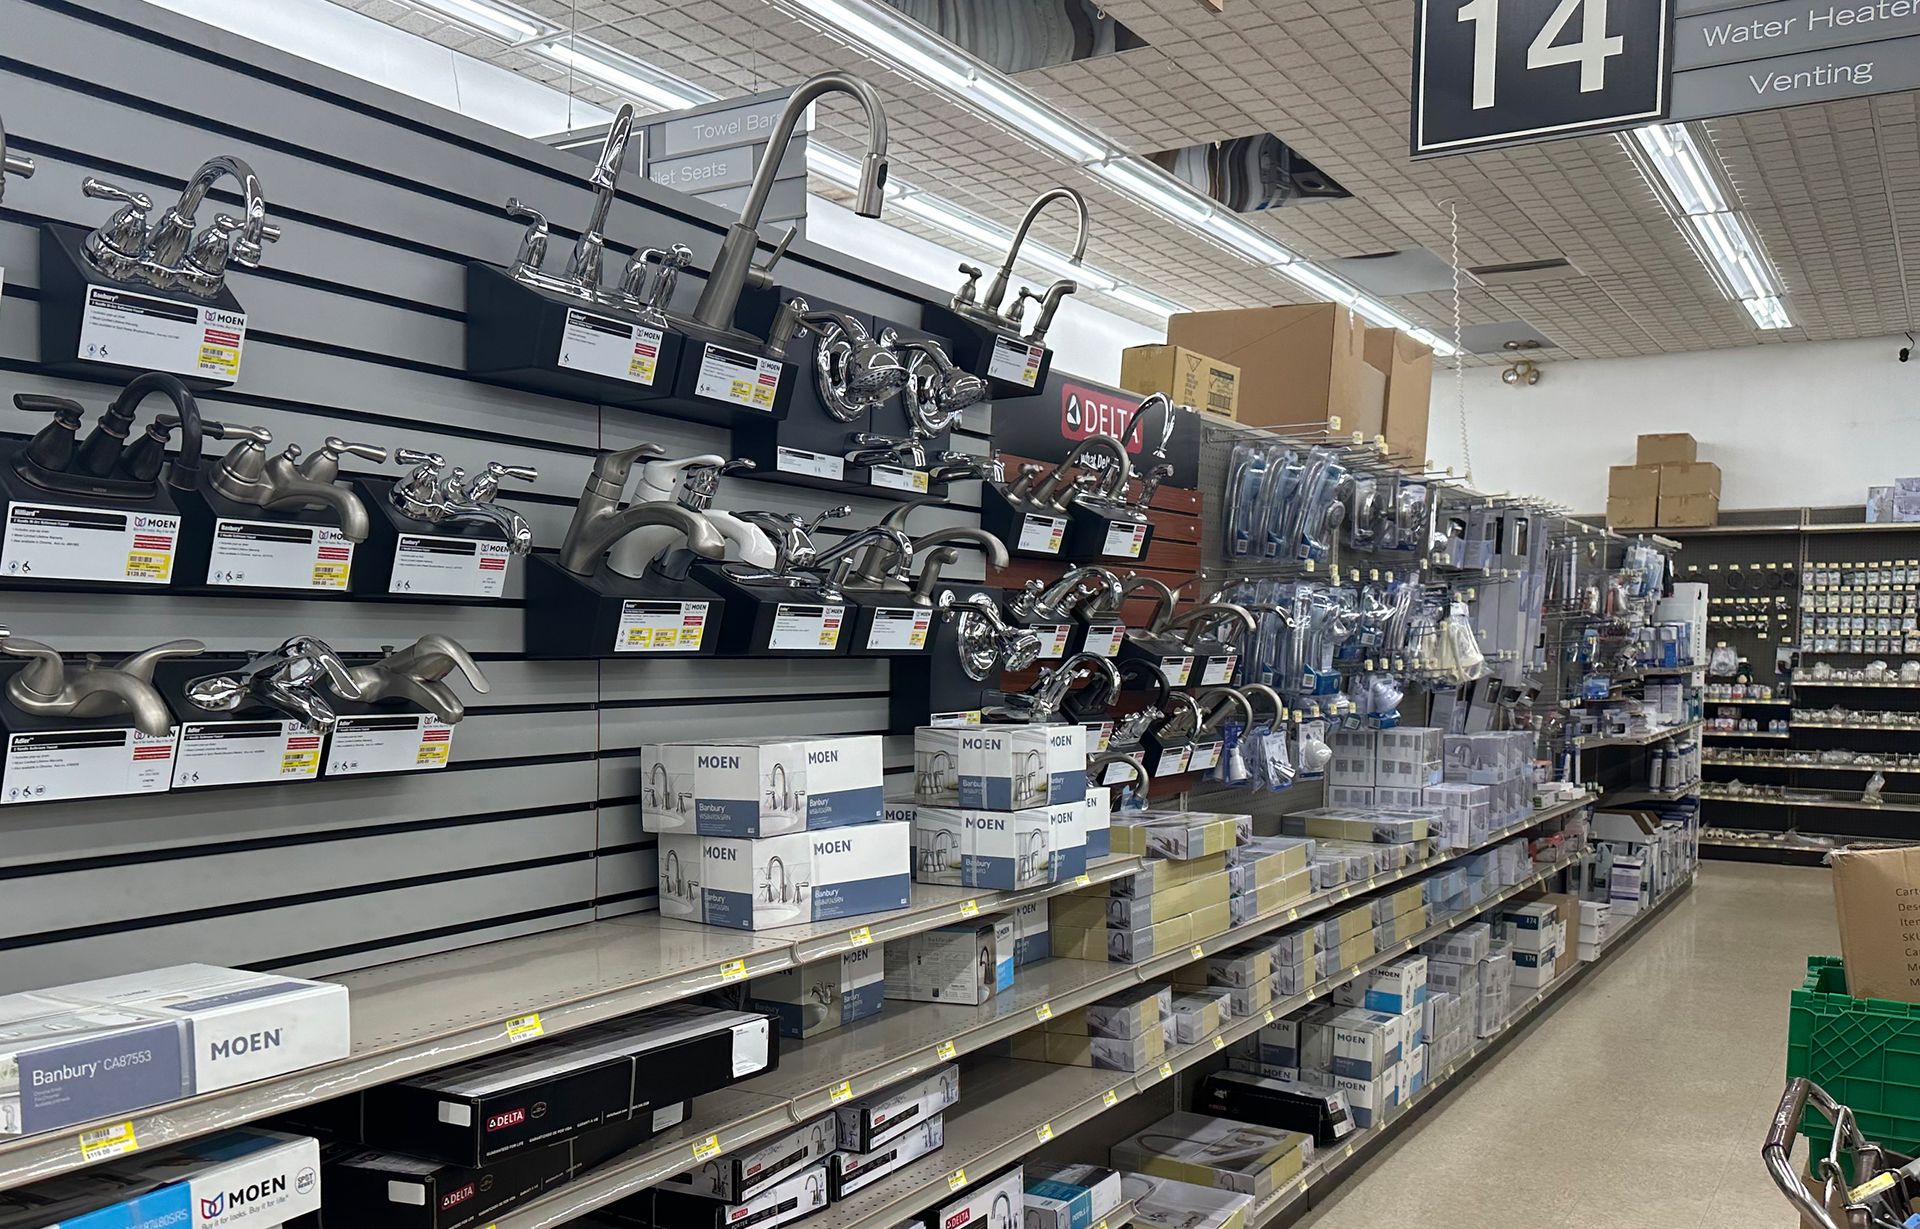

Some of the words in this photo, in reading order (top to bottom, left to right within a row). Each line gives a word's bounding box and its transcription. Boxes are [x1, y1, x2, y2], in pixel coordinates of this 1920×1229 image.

[1703, 16, 1796, 48] Water
[1456, 0, 1624, 110] 14
[1749, 59, 1875, 95] Venting
[693, 115, 741, 140] Towel
[681, 161, 728, 182] Seats
[217, 313, 244, 326] MOEN
[643, 331, 660, 341] MOEN
[147, 519, 177, 529] MOEN
[962, 738, 1001, 751] MOEN
[698, 755, 740, 769] MOEN
[808, 750, 839, 765] MOEN
[699, 803, 725, 813] Banbury
[965, 817, 1005, 831] MOEN
[703, 845, 736, 861] MOEN
[814, 839, 851, 856] MOEN
[843, 948, 869, 965] MOEN
[1378, 969, 1400, 979] MOEN
[211, 1029, 281, 1061] MOEN
[1337, 1033, 1366, 1044] MOEN
[32, 1062, 97, 1087] Banbury
[103, 1049, 152, 1072] CA87553
[1264, 1068, 1291, 1079] MOEN
[1337, 1080, 1366, 1092] MOEN
[497, 1110, 524, 1127] DELTA
[297, 1172, 314, 1184] SPOT
[229, 1174, 286, 1209] MOEN
[450, 1186, 474, 1204] DELTA
[249, 1206, 261, 1215] Buy
[951, 1211, 969, 1228] DELTA
